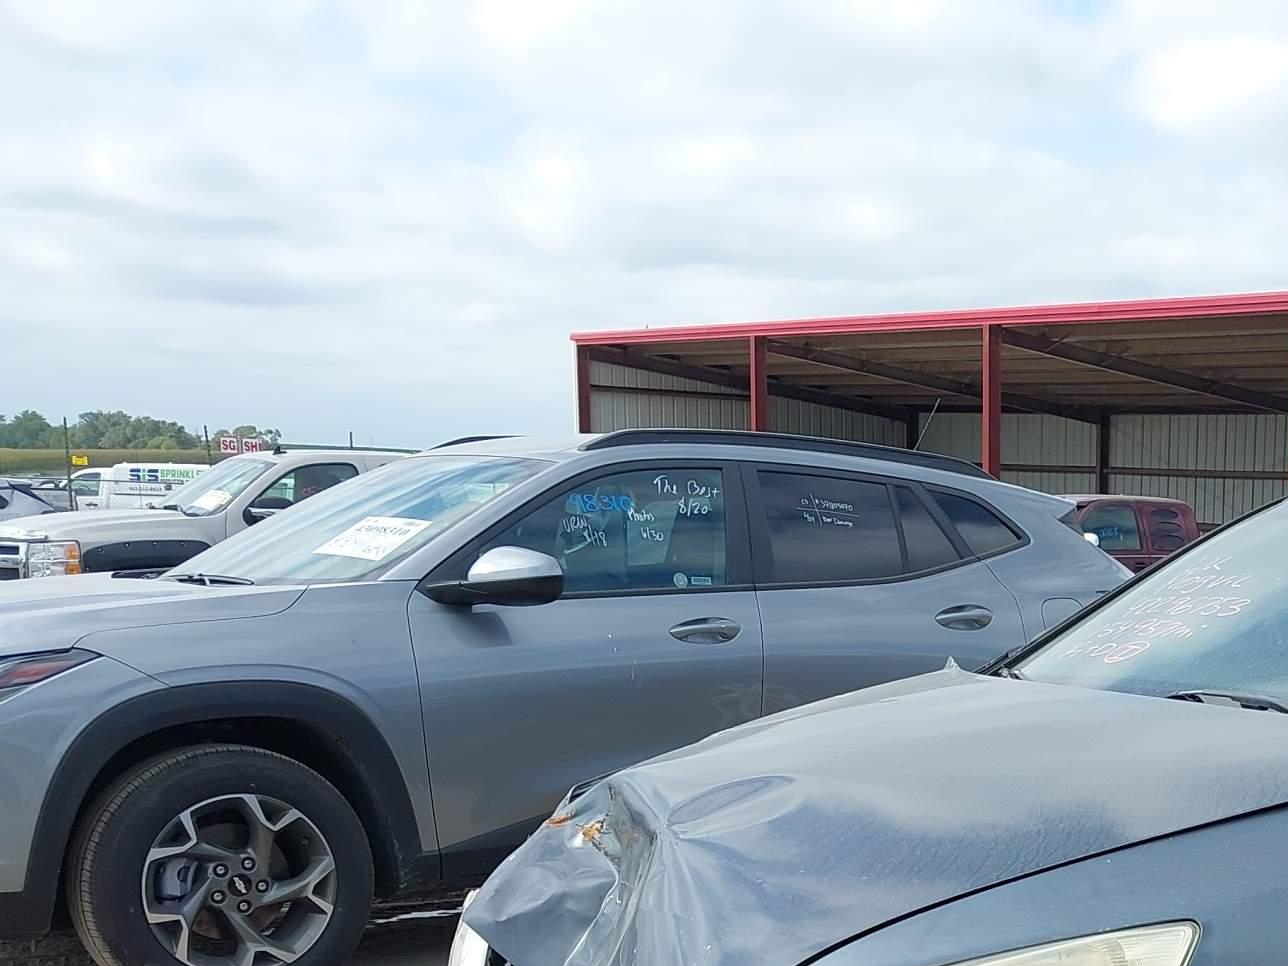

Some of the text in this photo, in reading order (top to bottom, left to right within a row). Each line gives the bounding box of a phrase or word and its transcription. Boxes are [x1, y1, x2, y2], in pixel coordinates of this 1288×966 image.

[222, 440, 236, 450] SG
[654, 475, 720, 498] The Best
[570, 493, 634, 512] 98310
[679, 499, 708, 517] 8/20
